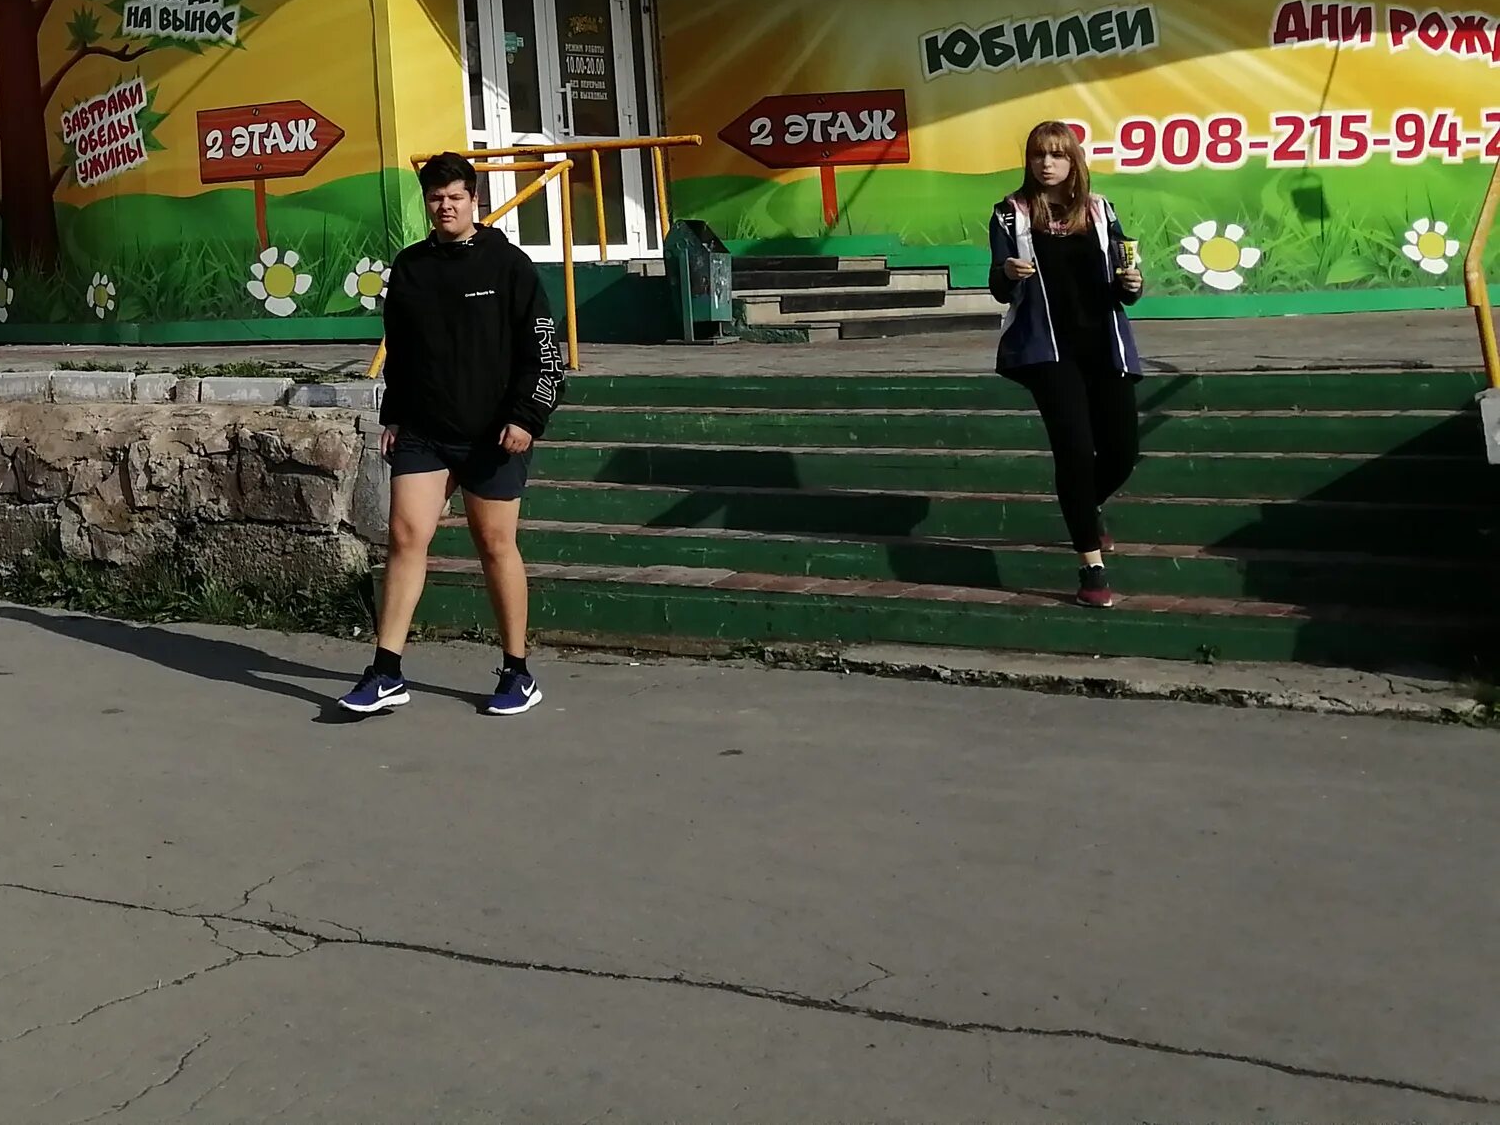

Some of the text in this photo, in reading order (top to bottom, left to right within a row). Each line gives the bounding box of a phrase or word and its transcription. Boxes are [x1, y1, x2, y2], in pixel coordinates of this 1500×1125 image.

[126, 6, 236, 36] НА ВЫНОС
[924, 7, 1155, 74] ЮБИЛЕИ
[1273, 0, 1500, 62] ДНИ РОЖ
[63, 82, 144, 139] ЗАВТРАКИ
[749, 108, 897, 146] 2 ЭТАЖ
[77, 114, 135, 156] ОБЕДЫ
[205, 118, 318, 160] 2 ЭТАЖ
[77, 138, 145, 184] УЖИНЫ
